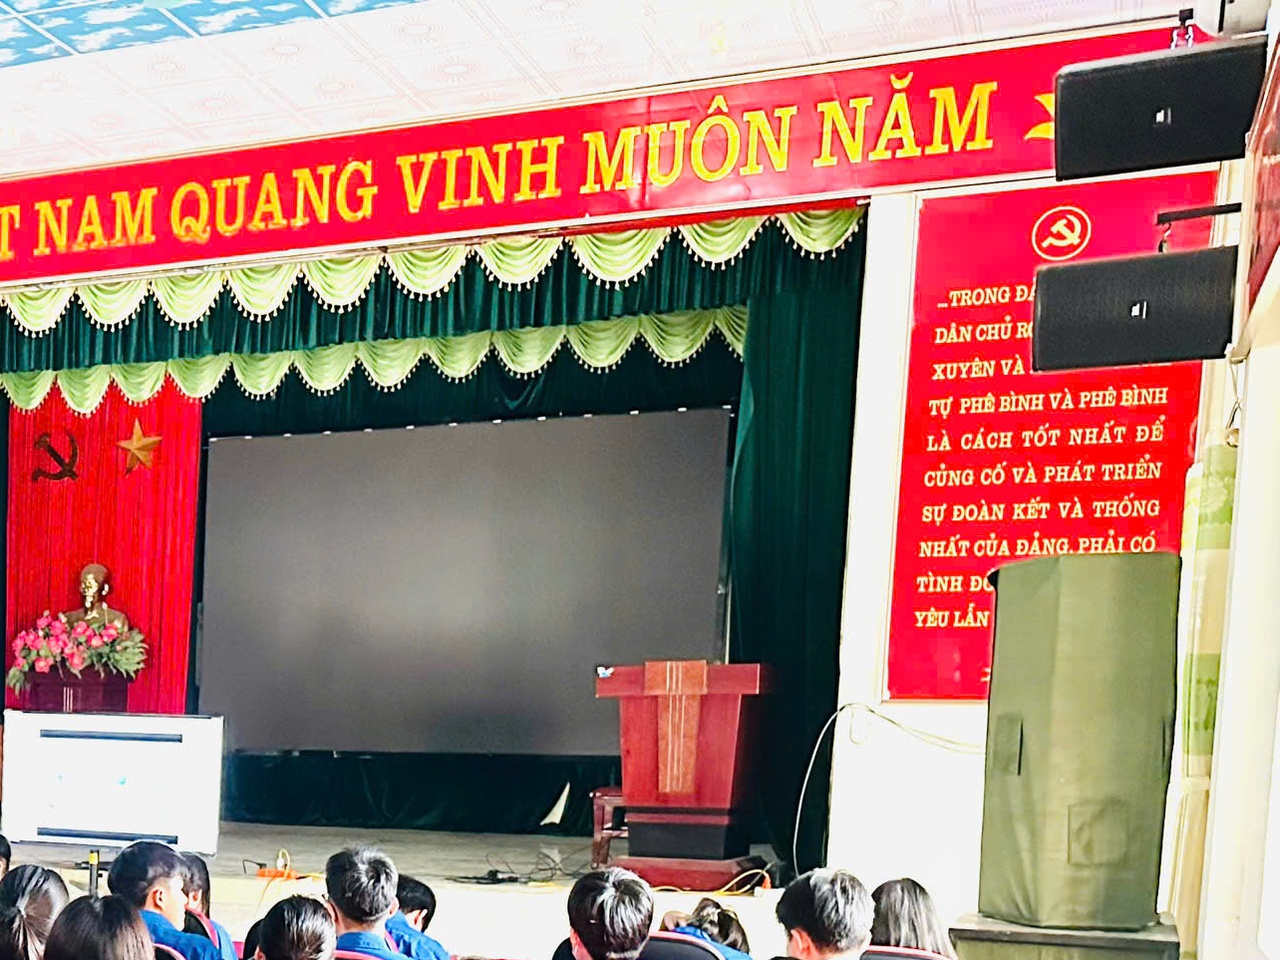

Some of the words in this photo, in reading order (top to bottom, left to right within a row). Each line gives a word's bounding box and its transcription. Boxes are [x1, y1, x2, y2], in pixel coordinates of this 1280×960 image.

[34, 188, 157, 255] NAM
[169, 158, 380, 245] QUANG
[396, 136, 564, 213] VINH
[578, 100, 793, 196] MUÔN
[810, 70, 997, 170] NĂM
[935, 323, 972, 343] DÂN
[976, 316, 1012, 341] CHỦ
[932, 357, 995, 380] XUYÊN
[1001, 354, 1025, 375] VÀ
[929, 397, 953, 419] TỰ
[960, 393, 995, 414] PHÊ
[999, 391, 1045, 412] BÌNH
[1049, 388, 1074, 409] VÀ
[1079, 386, 1116, 408] PHÊ
[1120, 385, 1168, 406] BÌNH
[927, 430, 951, 451] LÀ
[961, 428, 1013, 449] CÁCH
[1022, 423, 1060, 447] TỐT
[1069, 420, 1126, 445] NHẤT
[1136, 415, 1165, 442] ĐỂ
[924, 463, 974, 486] CỦNG
[981, 462, 1006, 485] CỐ
[1012, 462, 1037, 483] VÀ
[1044, 460, 1095, 482] PHÁT
[1102, 454, 1162, 480] TRIỂN
[922, 504, 946, 526] SỰ
[952, 500, 1005, 521] ĐOÀN
[1013, 497, 1050, 519] KẾT
[1059, 497, 1083, 518] VÀ
[1093, 493, 1160, 517] THỐNG
[919, 534, 970, 557] NHẤT
[974, 533, 1010, 556] CỦA
[1077, 530, 1125, 554] PHẢI
[1129, 531, 1157, 553] CÓ
[917, 572, 963, 592] TÌNH
[915, 607, 949, 627] YÊU
